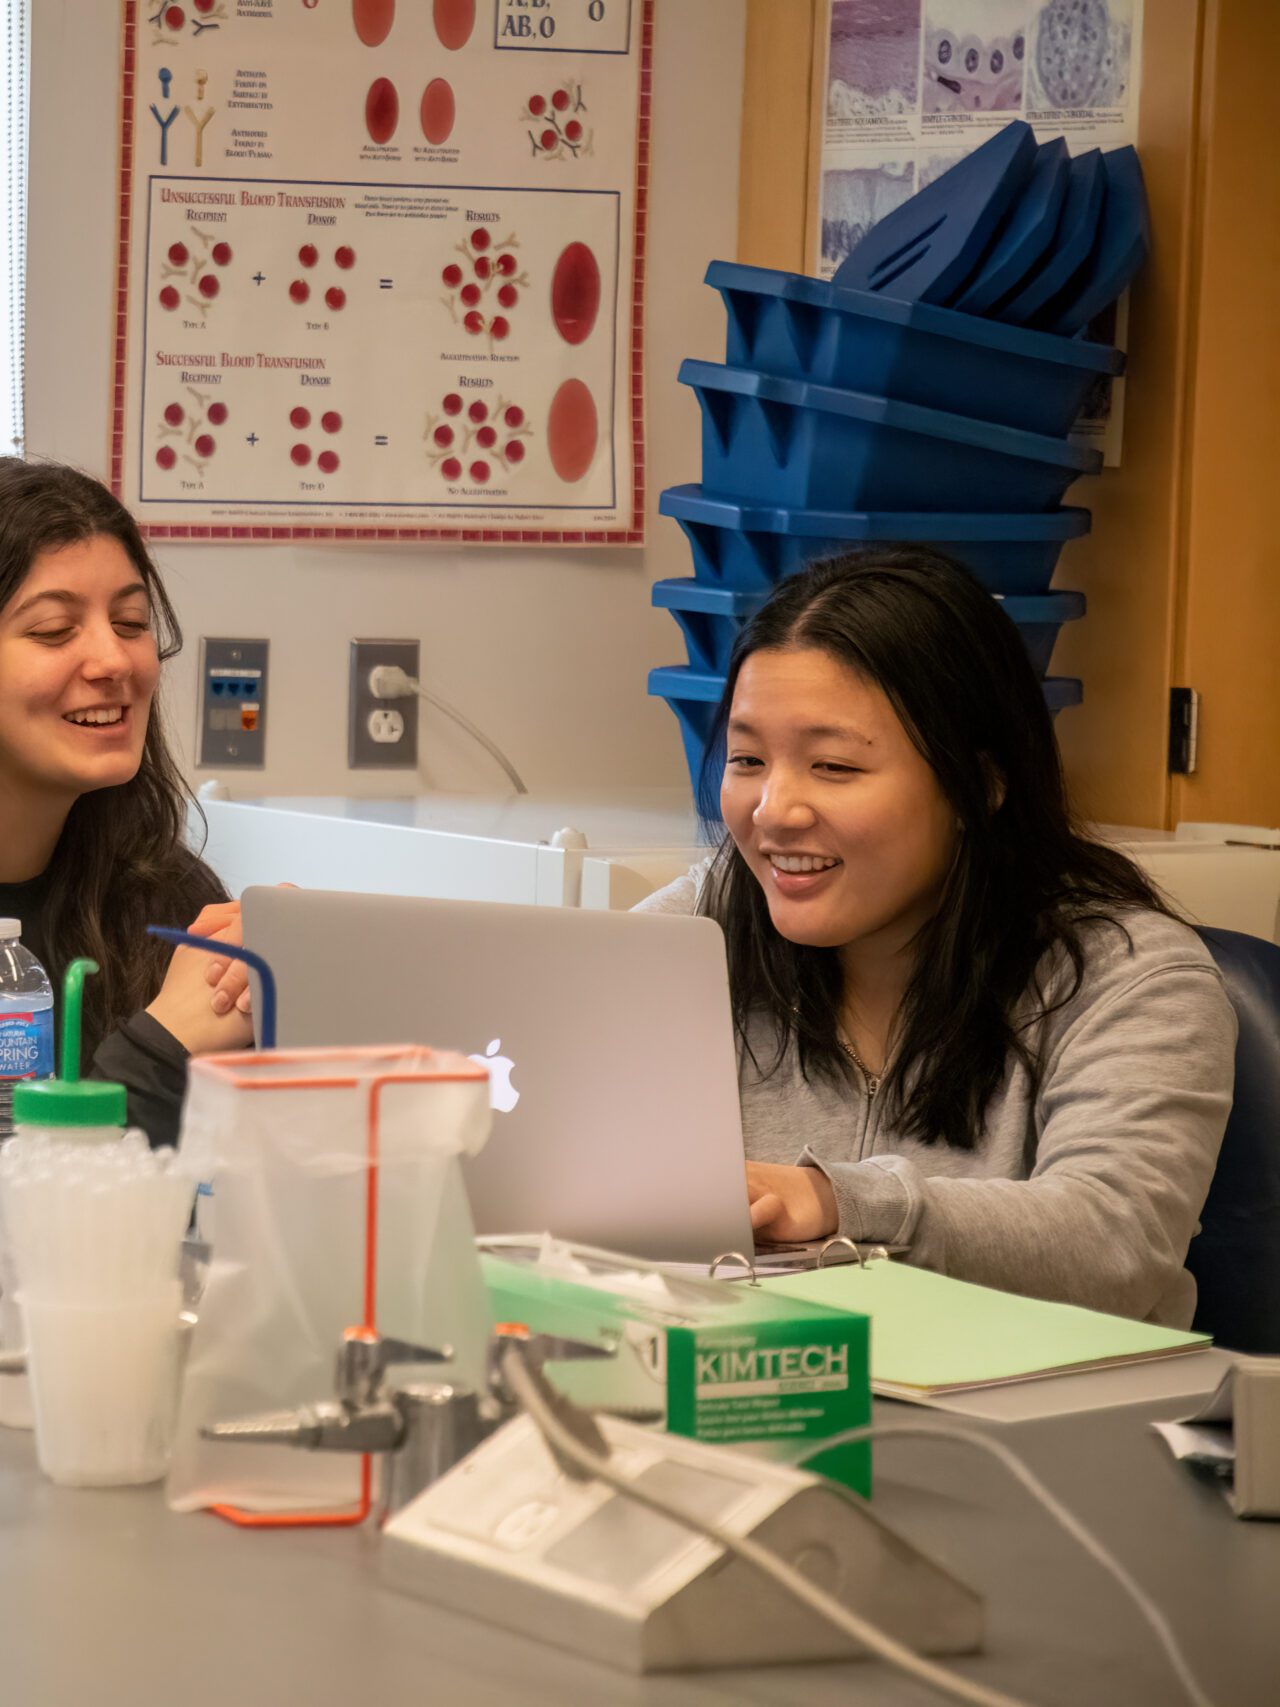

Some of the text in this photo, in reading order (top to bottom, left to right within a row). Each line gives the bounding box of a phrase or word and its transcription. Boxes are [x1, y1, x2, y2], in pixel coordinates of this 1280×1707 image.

[160, 188, 236, 205] UNSUCCESSFUL
[240, 190, 275, 207] BLOOD
[278, 192, 346, 209] TRANSFUSION
[186, 209, 227, 222] RECIPIENT
[307, 213, 337, 225] DONOR
[465, 210, 501, 223] RESULTS
[156, 351, 326, 369] SUCCESSFUL BLOOD TRANSFUSION
[181, 371, 222, 384] RECIPIENT
[300, 374, 331, 386] DONOR
[458, 375, 494, 388] RESULTS
[696, 1343, 848, 1384] KIMTECH
